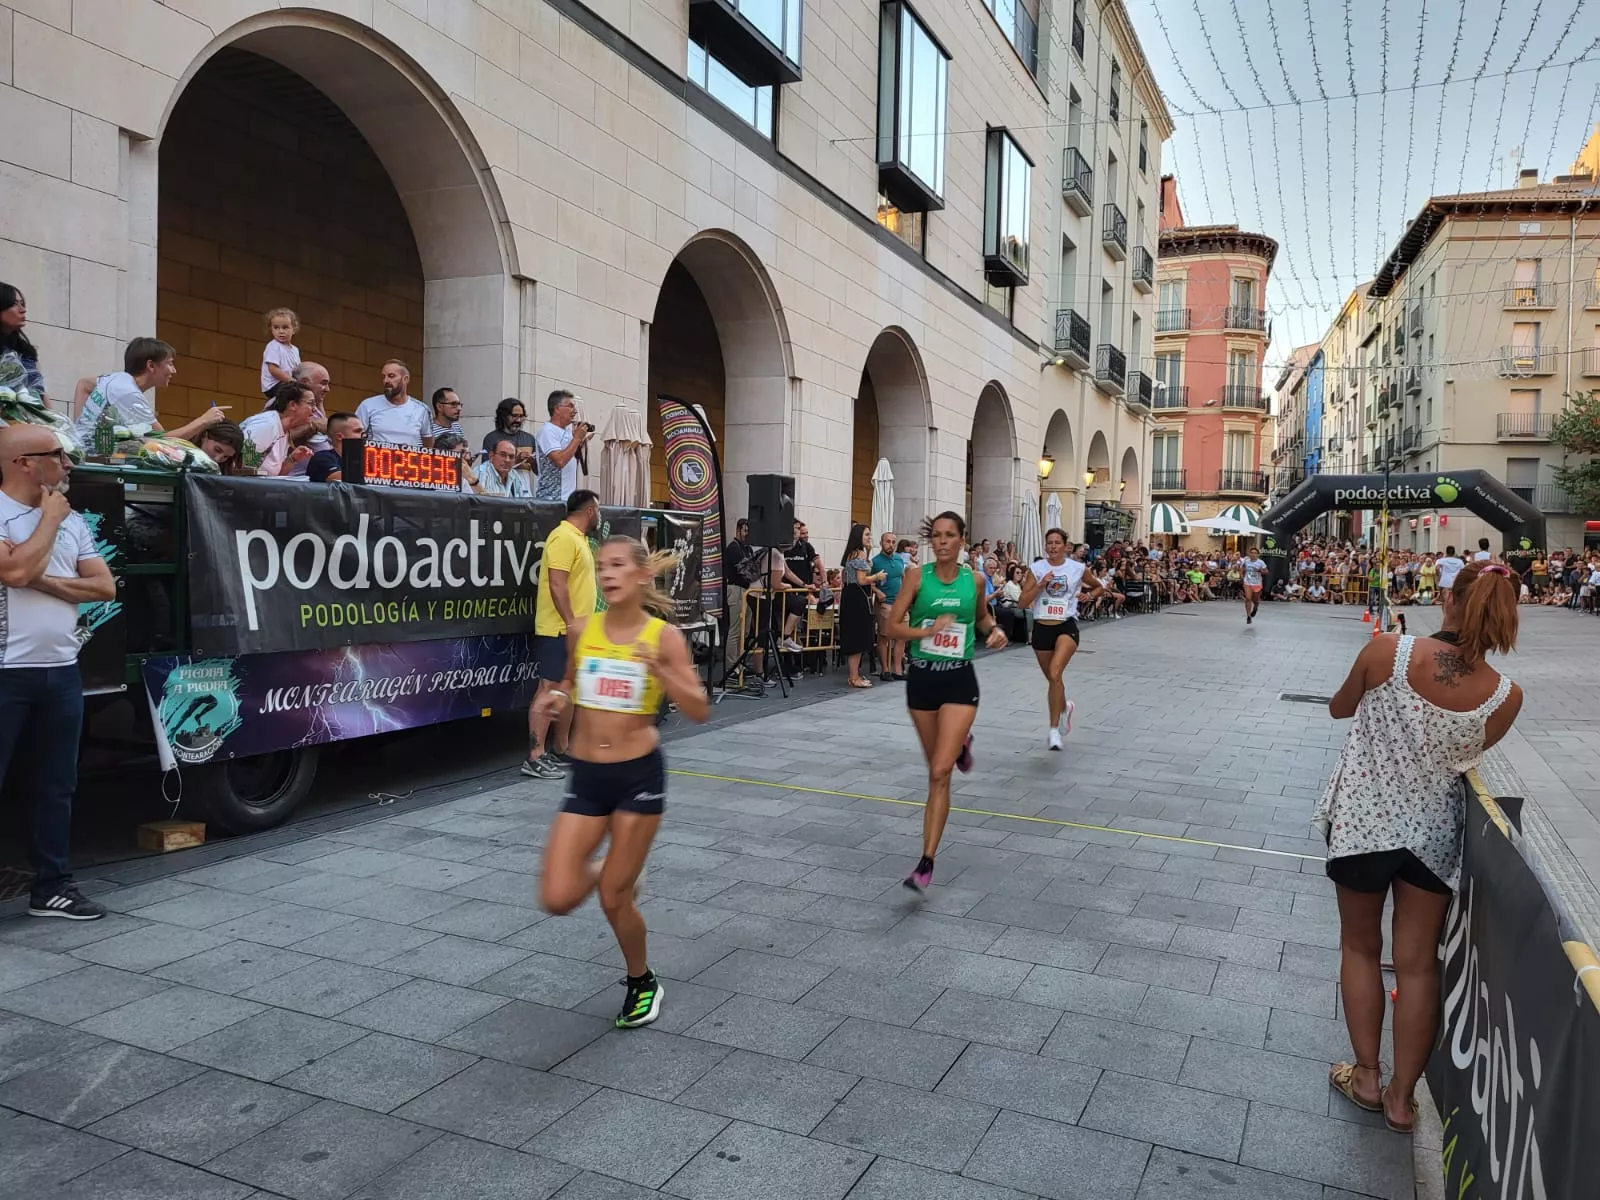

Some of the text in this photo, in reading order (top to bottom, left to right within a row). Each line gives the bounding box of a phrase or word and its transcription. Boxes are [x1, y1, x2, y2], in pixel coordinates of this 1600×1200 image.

[364, 440, 461, 458] JOYERIA CARLOS BAILIN
[363, 476, 461, 491] WWW.CARLOSBAILIN.ES
[1334, 485, 1431, 504] podoactiva
[300, 593, 536, 628] PODOLOGÍA Y BIOMECÁNI
[1047, 606, 1064, 615] 089
[933, 632, 960, 649] 084
[180, 668, 224, 680] PIEDRA
[187, 681, 228, 692] PIEDRA
[259, 661, 540, 713] MONTEARAGÓN PIEDRA A PIE
